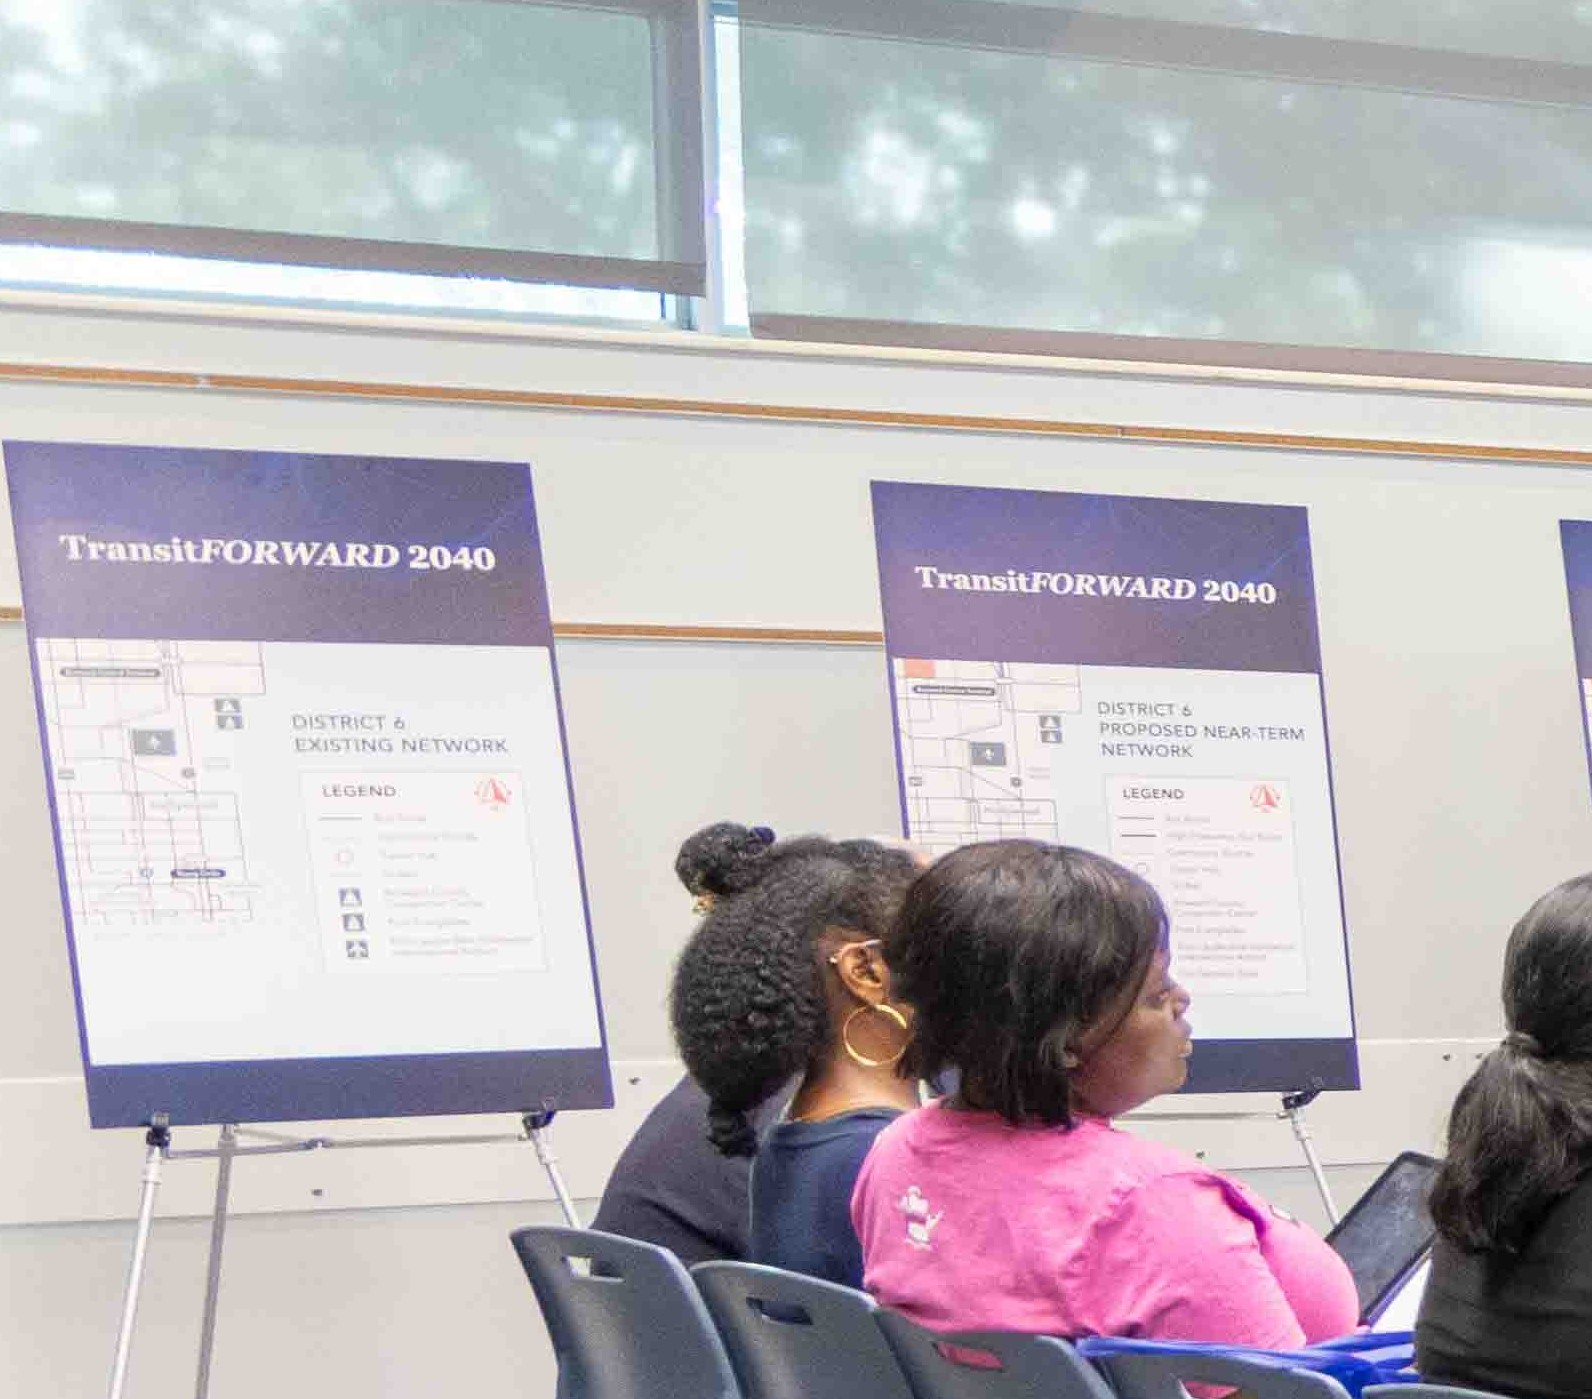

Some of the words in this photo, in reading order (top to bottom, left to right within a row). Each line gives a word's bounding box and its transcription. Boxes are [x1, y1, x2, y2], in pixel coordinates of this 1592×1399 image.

[60, 534, 400, 569] TransitFORWARD
[408, 544, 497, 571] 2040
[915, 566, 1196, 600] TransitFORWARD
[1202, 580, 1277, 605] 2040
[1098, 701, 1175, 717] DISTRICT
[1181, 703, 1192, 717] 6
[291, 714, 387, 731] DISTRICT
[393, 716, 406, 731] 6
[1099, 722, 1198, 738] PROPOSED
[1203, 724, 1306, 742] NEAR-TERM
[294, 737, 394, 753] EXISTING
[401, 738, 509, 753] NETWORK
[1101, 743, 1194, 758] NETWORK
[322, 785, 398, 798] LEGEND
[1122, 787, 1185, 800] LEGEND
